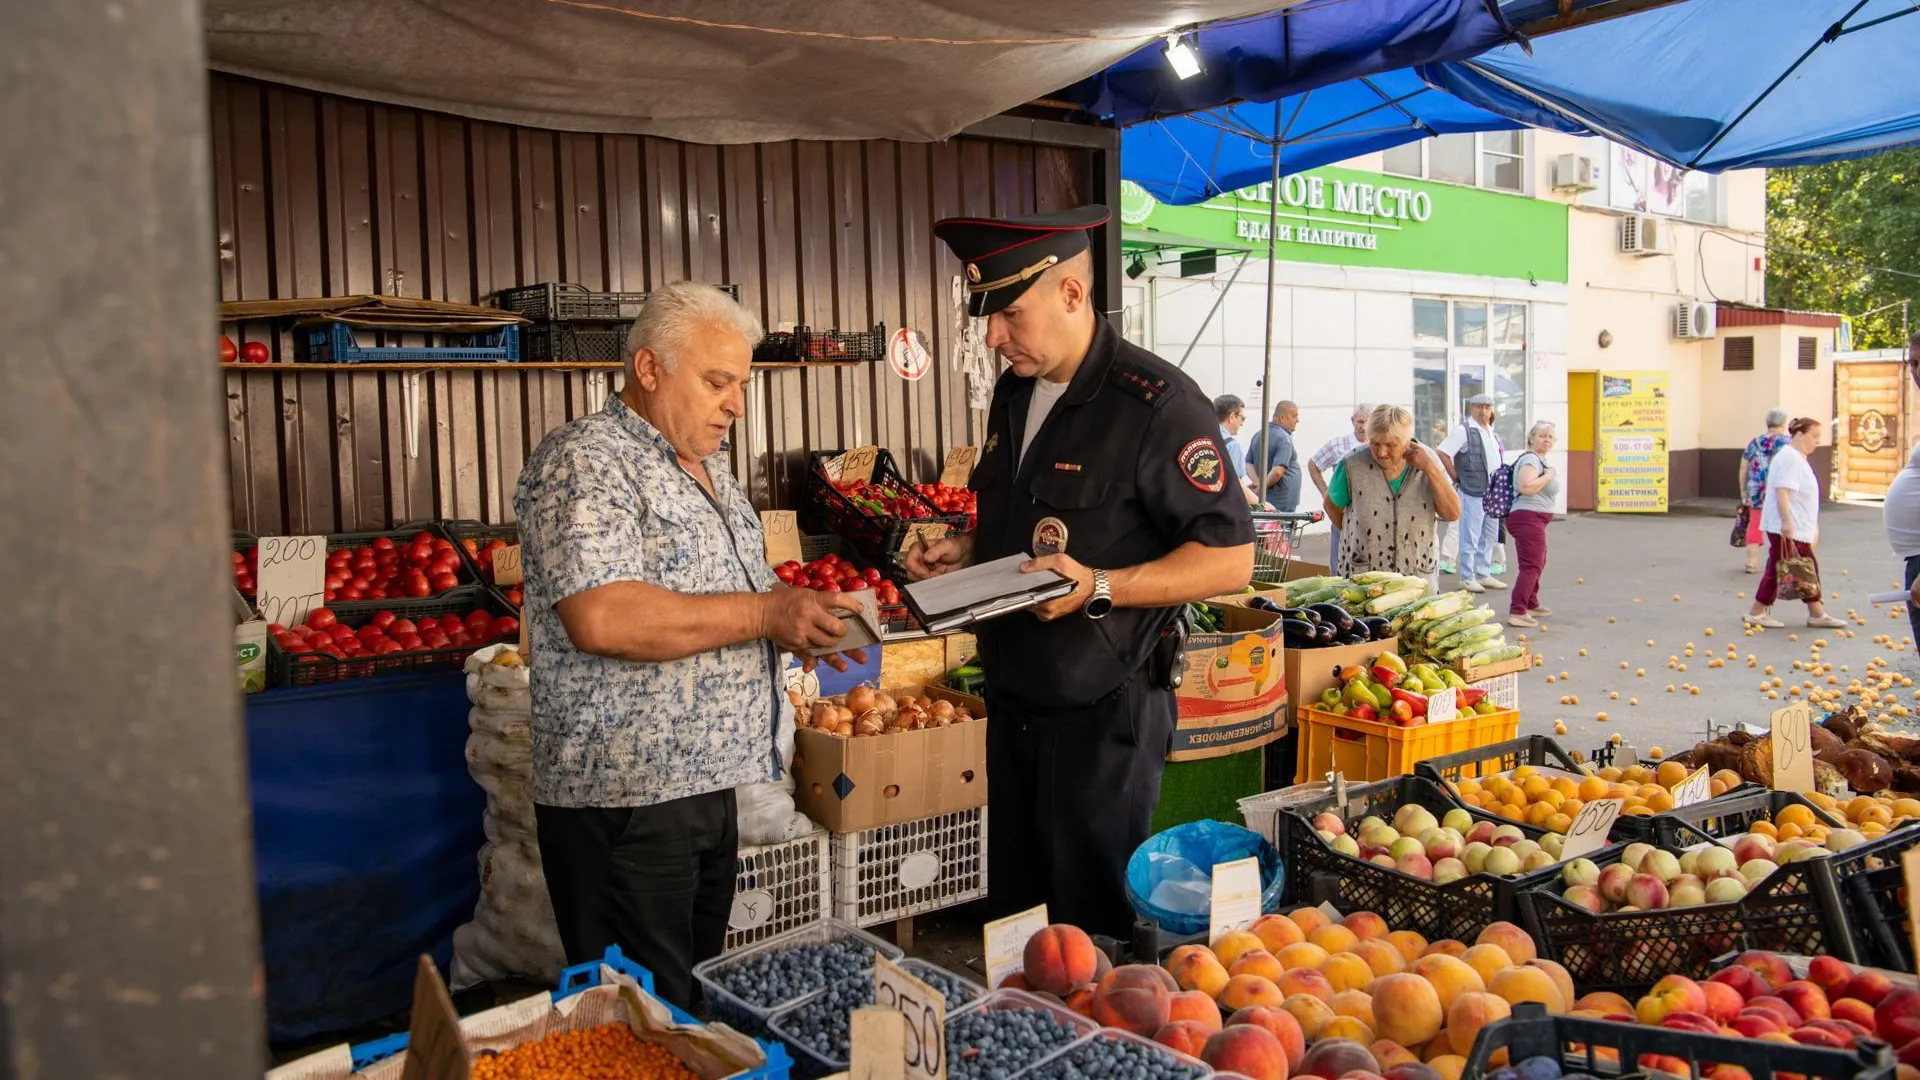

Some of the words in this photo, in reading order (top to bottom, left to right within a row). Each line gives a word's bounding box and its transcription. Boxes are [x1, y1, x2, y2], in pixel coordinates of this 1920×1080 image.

[1333, 180, 1432, 222] МЕСТО
[1237, 219, 1271, 242] ЕДА
[1278, 224, 1292, 242] И
[1296, 226, 1377, 249] НАПИТКИ
[845, 451, 874, 471] 150
[1181, 440, 1213, 463] ПОЛИЦИЯ
[1187, 449, 1216, 472] РОССИЯ
[1609, 500, 1657, 508] НАУШНИКИ
[766, 511, 794, 536] 150
[263, 538, 316, 568] 200
[1187, 636, 1223, 644] BANANAS
[1780, 709, 1806, 771] 80
[1570, 801, 1617, 838] 150
